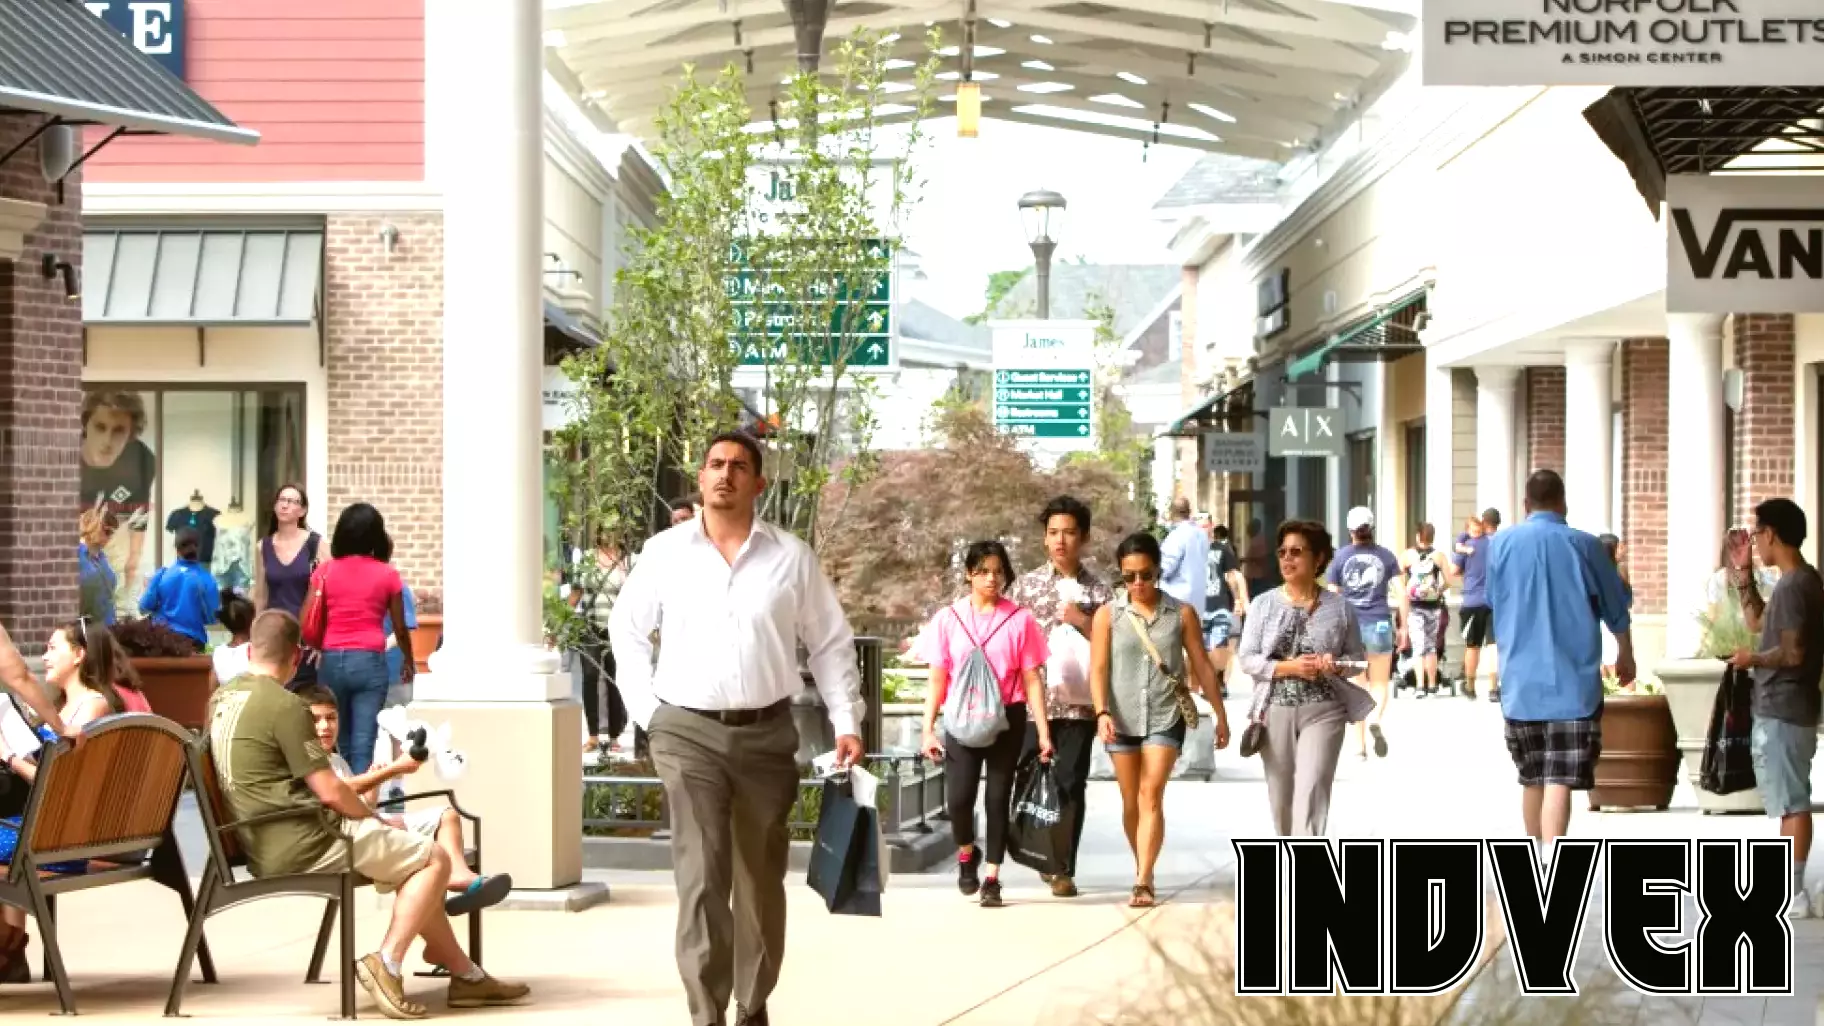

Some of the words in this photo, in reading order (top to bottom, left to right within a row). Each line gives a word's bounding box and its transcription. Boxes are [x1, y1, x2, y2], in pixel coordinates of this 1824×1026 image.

[1543, 0, 1739, 13] NORFOLK
[1444, 21, 1637, 44] PREMIUM
[1649, 20, 1824, 43] OUTLETS
[1562, 53, 1573, 63] A
[1579, 53, 1640, 63] SIMON
[1647, 53, 1722, 63] CENTER
